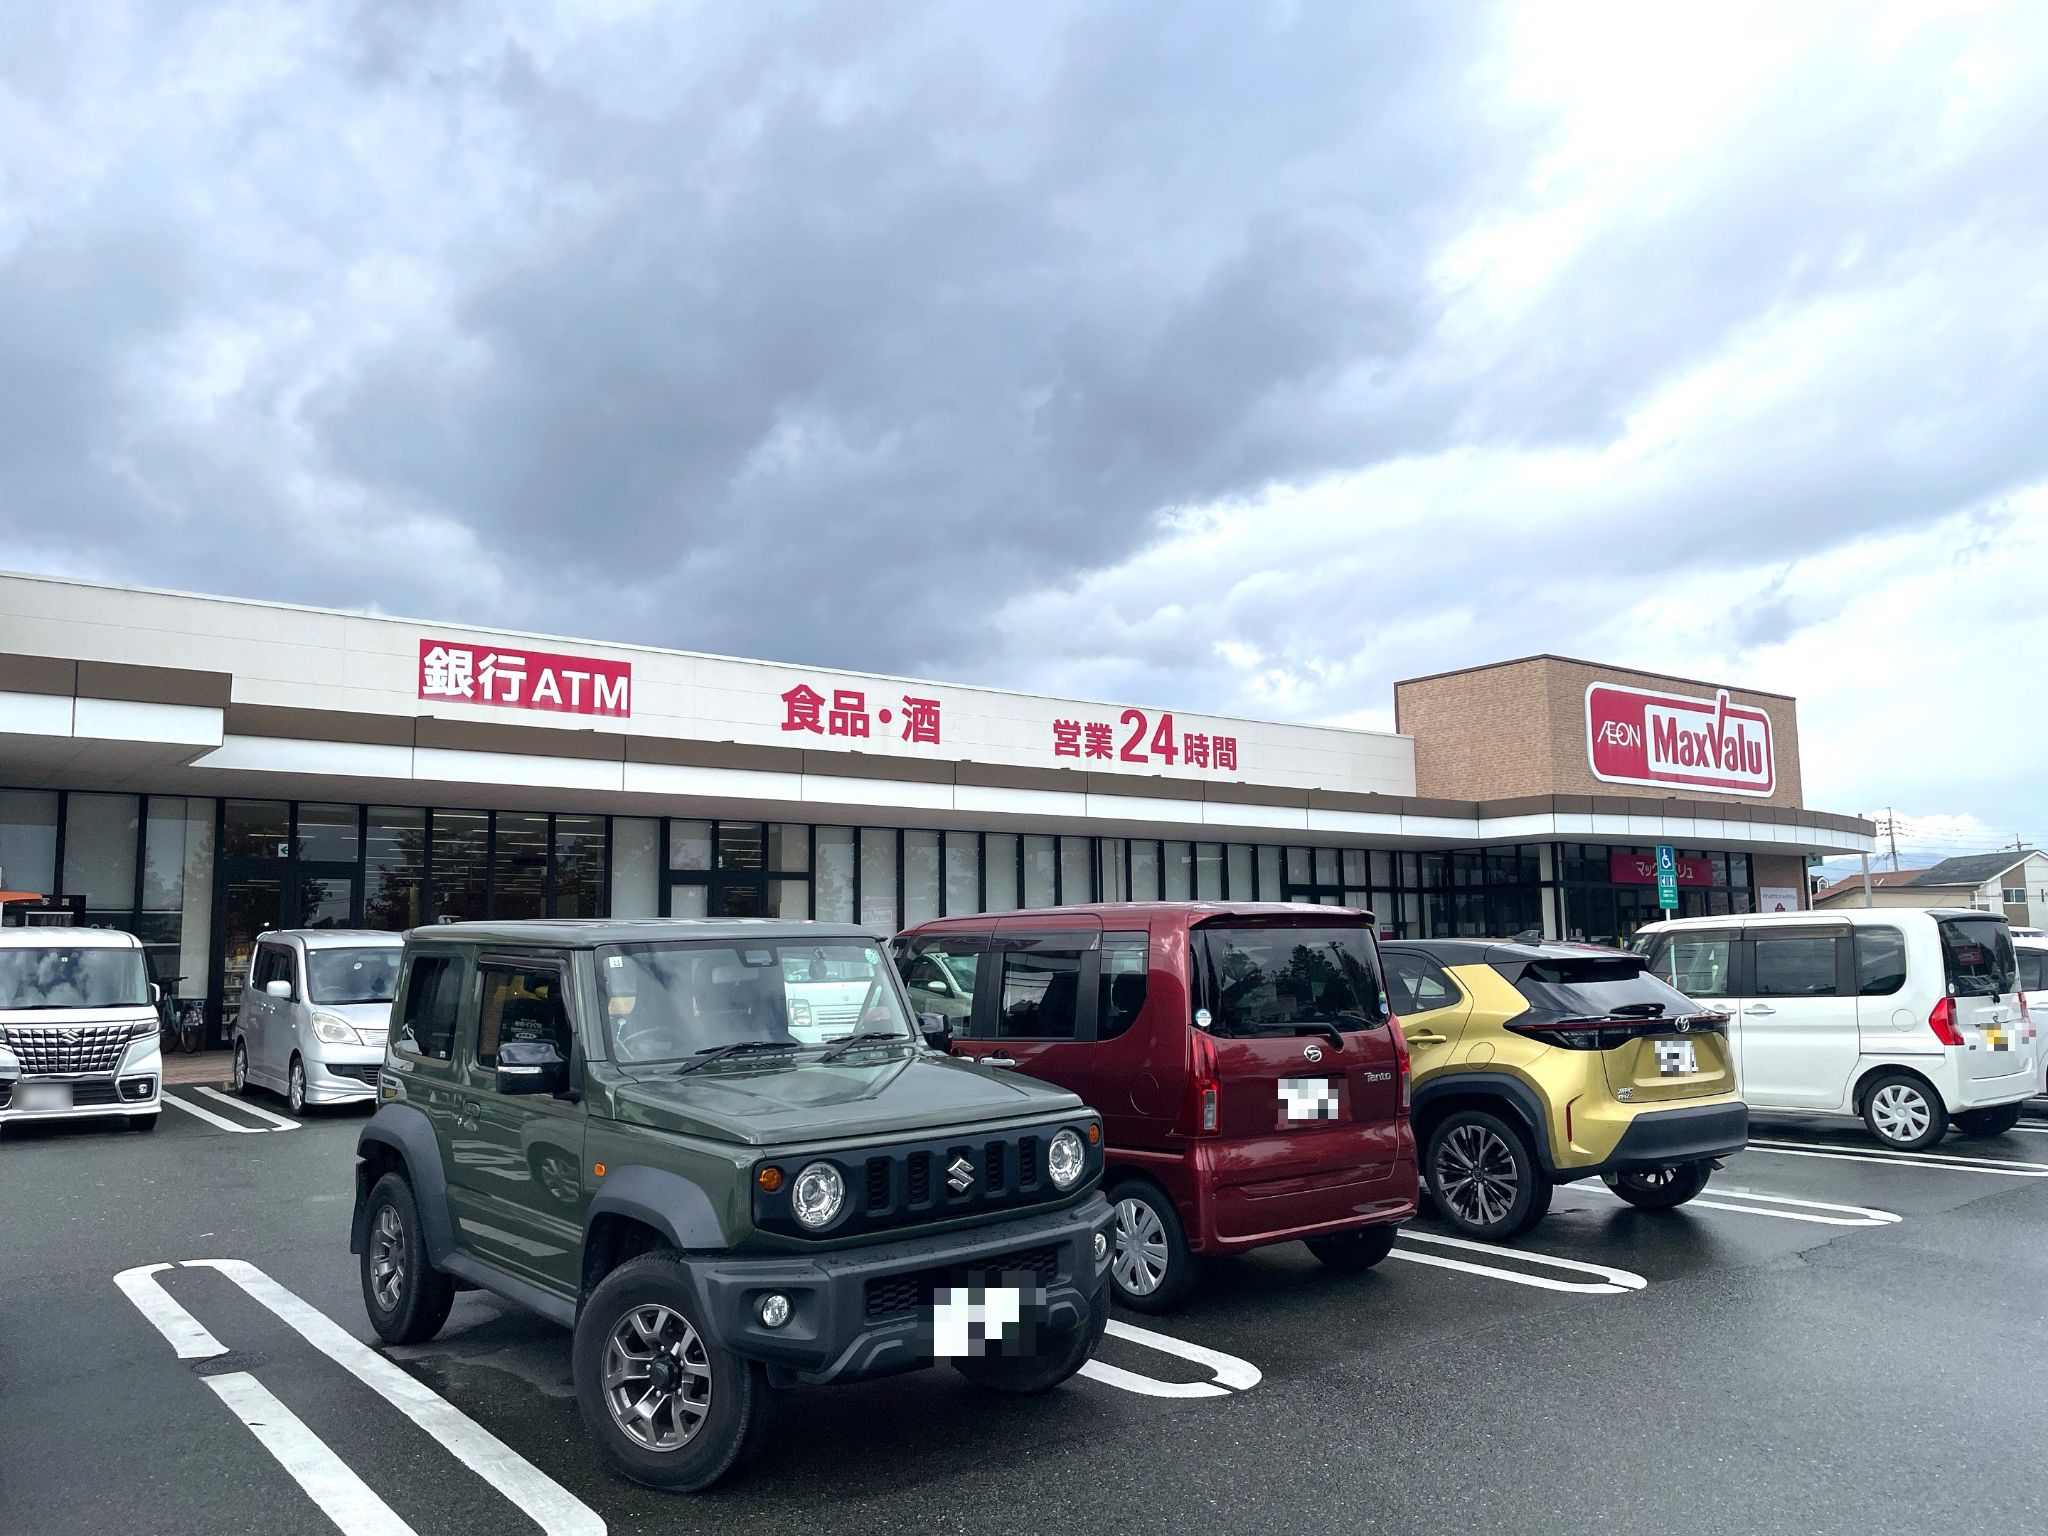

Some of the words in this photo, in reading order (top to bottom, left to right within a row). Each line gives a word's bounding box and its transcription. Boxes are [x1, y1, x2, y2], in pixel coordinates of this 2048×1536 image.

[422, 646, 629, 711] 銀行ATM
[781, 684, 940, 744] 食品・酒
[1053, 709, 1237, 771] 営業24時間
[1652, 694, 1763, 775] MaxValu
[1363, 1072, 1392, 1083] Tanto
